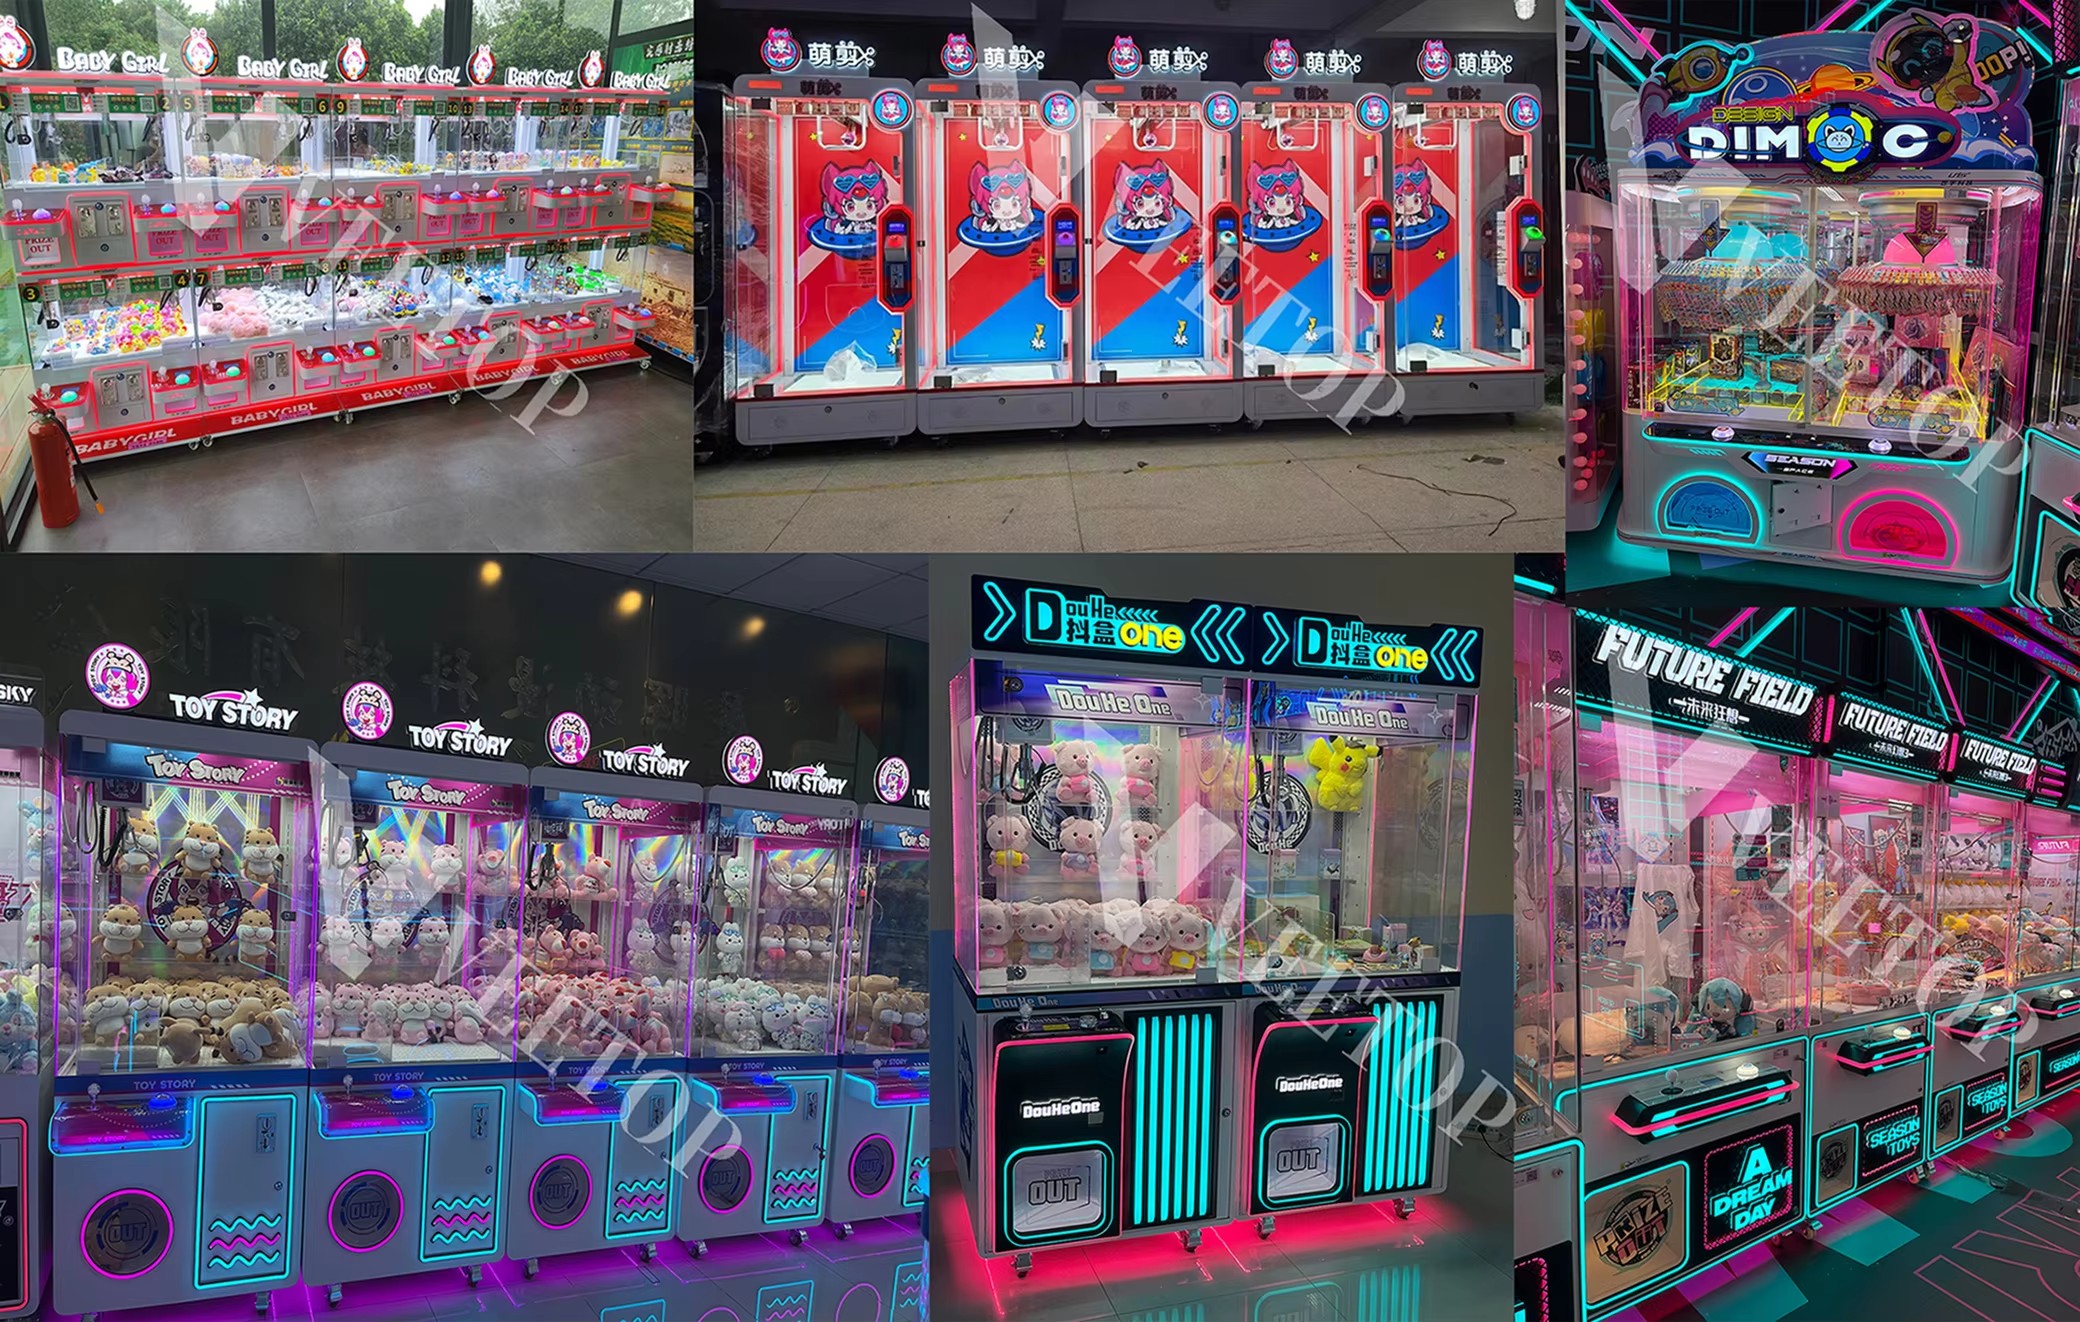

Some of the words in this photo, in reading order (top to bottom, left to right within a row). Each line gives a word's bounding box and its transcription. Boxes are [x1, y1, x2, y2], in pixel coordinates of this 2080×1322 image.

[57, 47, 116, 73] BABY
[121, 51, 170, 73] GIRL
[237, 55, 285, 78] BABY
[289, 57, 329, 80] GIRL
[382, 62, 425, 84] BABY
[426, 65, 461, 85] GIRL
[505, 67, 543, 87] BABY
[541, 69, 574, 87] GIRL
[610, 71, 643, 89] BABY
[642, 72, 671, 90] GIRL
[162, 97, 170, 110] 2
[184, 98, 192, 110] 5
[318, 100, 326, 112] 6
[336, 99, 344, 112] 9
[1712, 105, 1796, 124] DESIGN
[30, 245, 51, 253] OUT
[156, 237, 174, 245] OUT
[322, 262, 329, 273] 8
[177, 275, 186, 286] 4
[197, 274, 205, 285] 7
[27, 288, 35, 300] 3
[1764, 454, 1837, 467] SEASON
[1783, 467, 1815, 475] SPACE
[1120, 621, 1184, 650] one
[1376, 646, 1429, 671] one
[1595, 624, 1732, 695] FUTURE
[1732, 668, 1815, 716] FIELD
[169, 693, 218, 721] TOY
[221, 700, 298, 731] STORY
[1056, 688, 1132, 714] DouHe
[1134, 692, 1171, 716] One
[1316, 705, 1375, 728] DouHe
[1377, 710, 1409, 730] One
[1844, 702, 1906, 745] FUTURE
[1906, 722, 1949, 753] FIELD
[408, 725, 450, 749] TOY
[450, 732, 512, 757] STORY
[602, 749, 637, 771] TOY
[637, 754, 690, 778] STORY
[1965, 740, 2007, 768] FUTURE
[2007, 753, 2038, 776] FIELD
[772, 770, 801, 791] TOY
[801, 775, 848, 795] STORY
[134, 1080, 157, 1090] TOY
[160, 1079, 196, 1090] STORY
[374, 1072, 393, 1081] TOY
[394, 1071, 424, 1081] STORY
[1279, 1076, 1343, 1093] DouHeOne
[1971, 1081, 2007, 1107] SEASON
[1022, 1100, 1101, 1119] DouHeOne
[1869, 1117, 1920, 1149] SEASON
[1889, 1133, 1920, 1156] TOYS
[1276, 1148, 1320, 1172] OUT
[1741, 1145, 1772, 1183] A
[712, 1169, 735, 1185] OUT
[546, 1182, 571, 1199] OUT
[1028, 1177, 1081, 1206] OUT
[1713, 1168, 1792, 1217] DREAM
[350, 1200, 383, 1220] OUT
[1593, 1186, 1673, 1256] PRIZE
[1732, 1196, 1775, 1231] DAY
[109, 1222, 147, 1243] OUT
[1617, 1214, 1667, 1266] OUT
